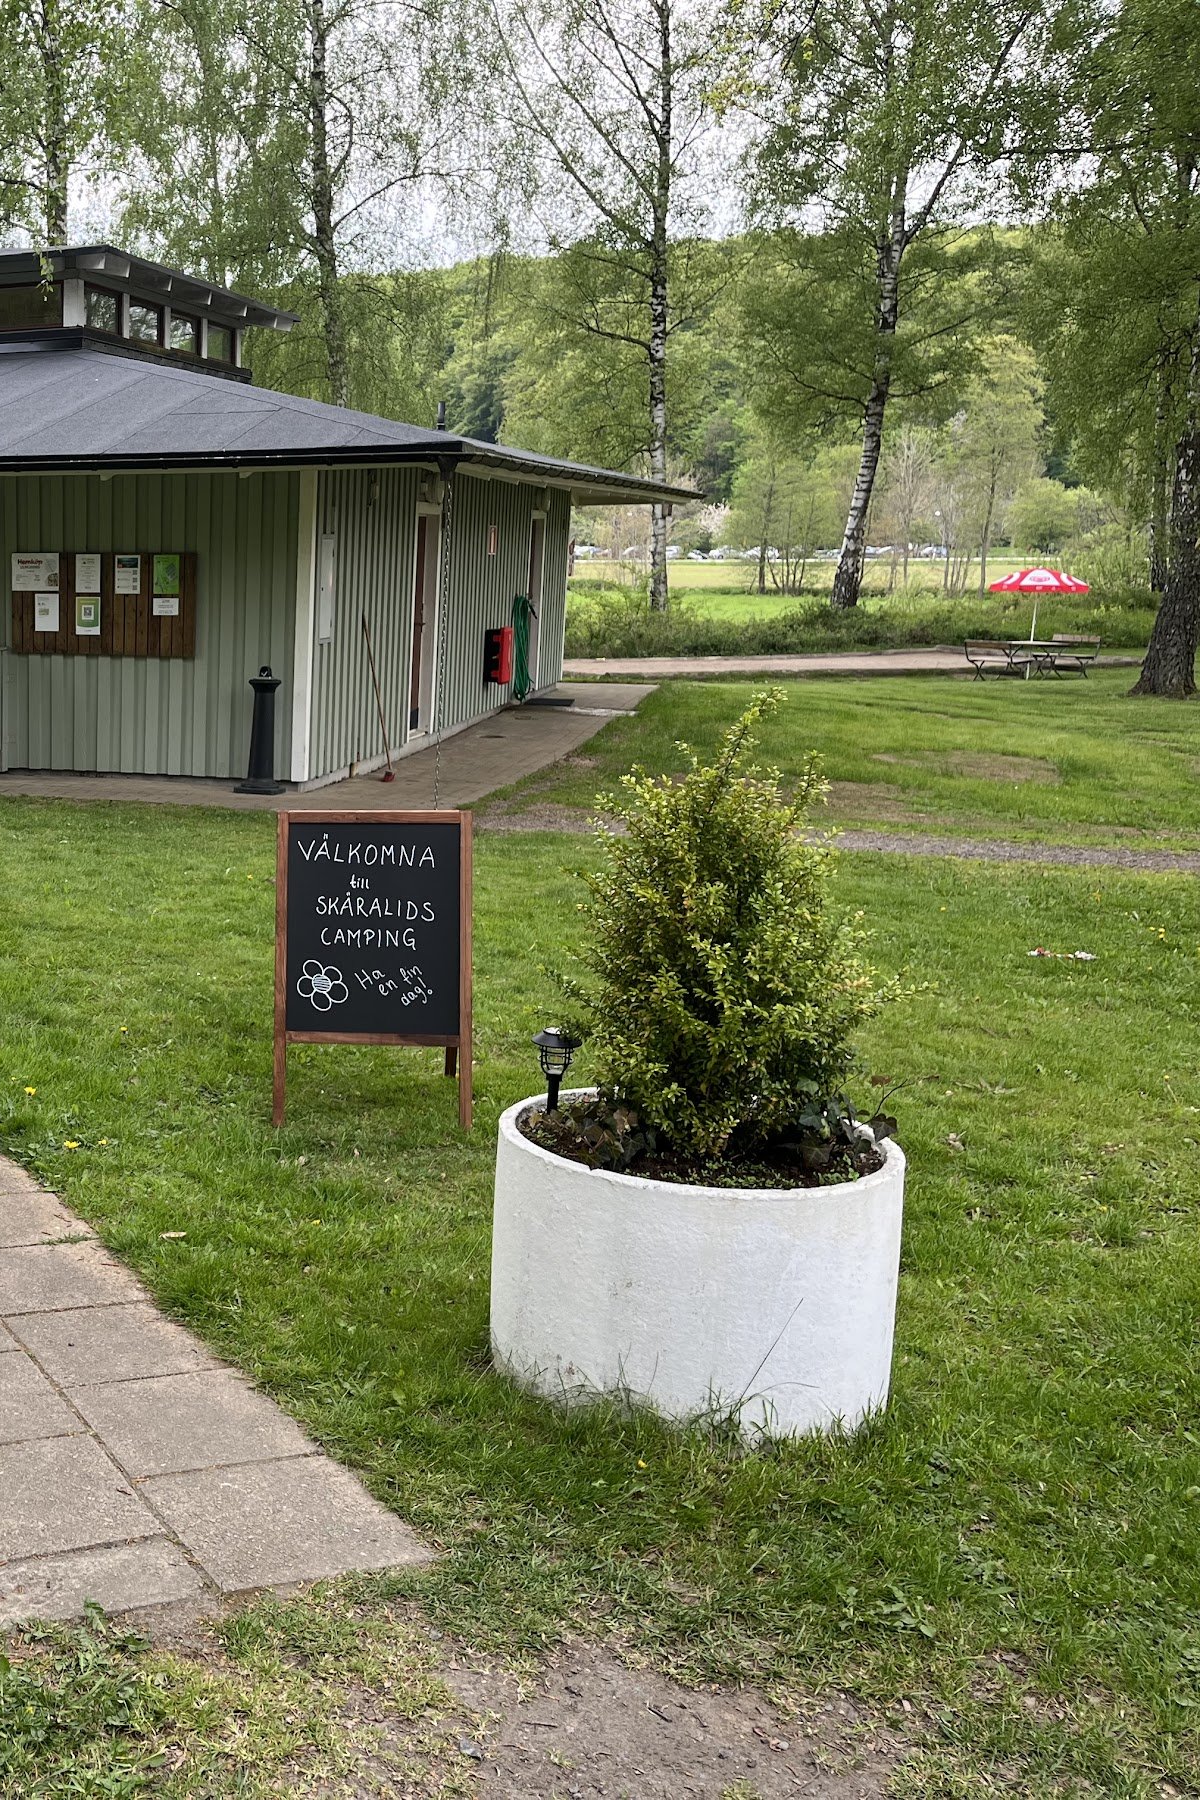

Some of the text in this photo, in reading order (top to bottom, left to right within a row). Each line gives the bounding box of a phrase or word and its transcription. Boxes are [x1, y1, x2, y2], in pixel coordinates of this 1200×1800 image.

[297, 833, 435, 868] VÄLKOMNA
[349, 873, 370, 890] till
[315, 892, 435, 922] SKÄRALIDS
[320, 927, 417, 951] CAMPING
[354, 968, 386, 990] Ha
[378, 965, 423, 997] en fin
[400, 978, 433, 1006] dag!
